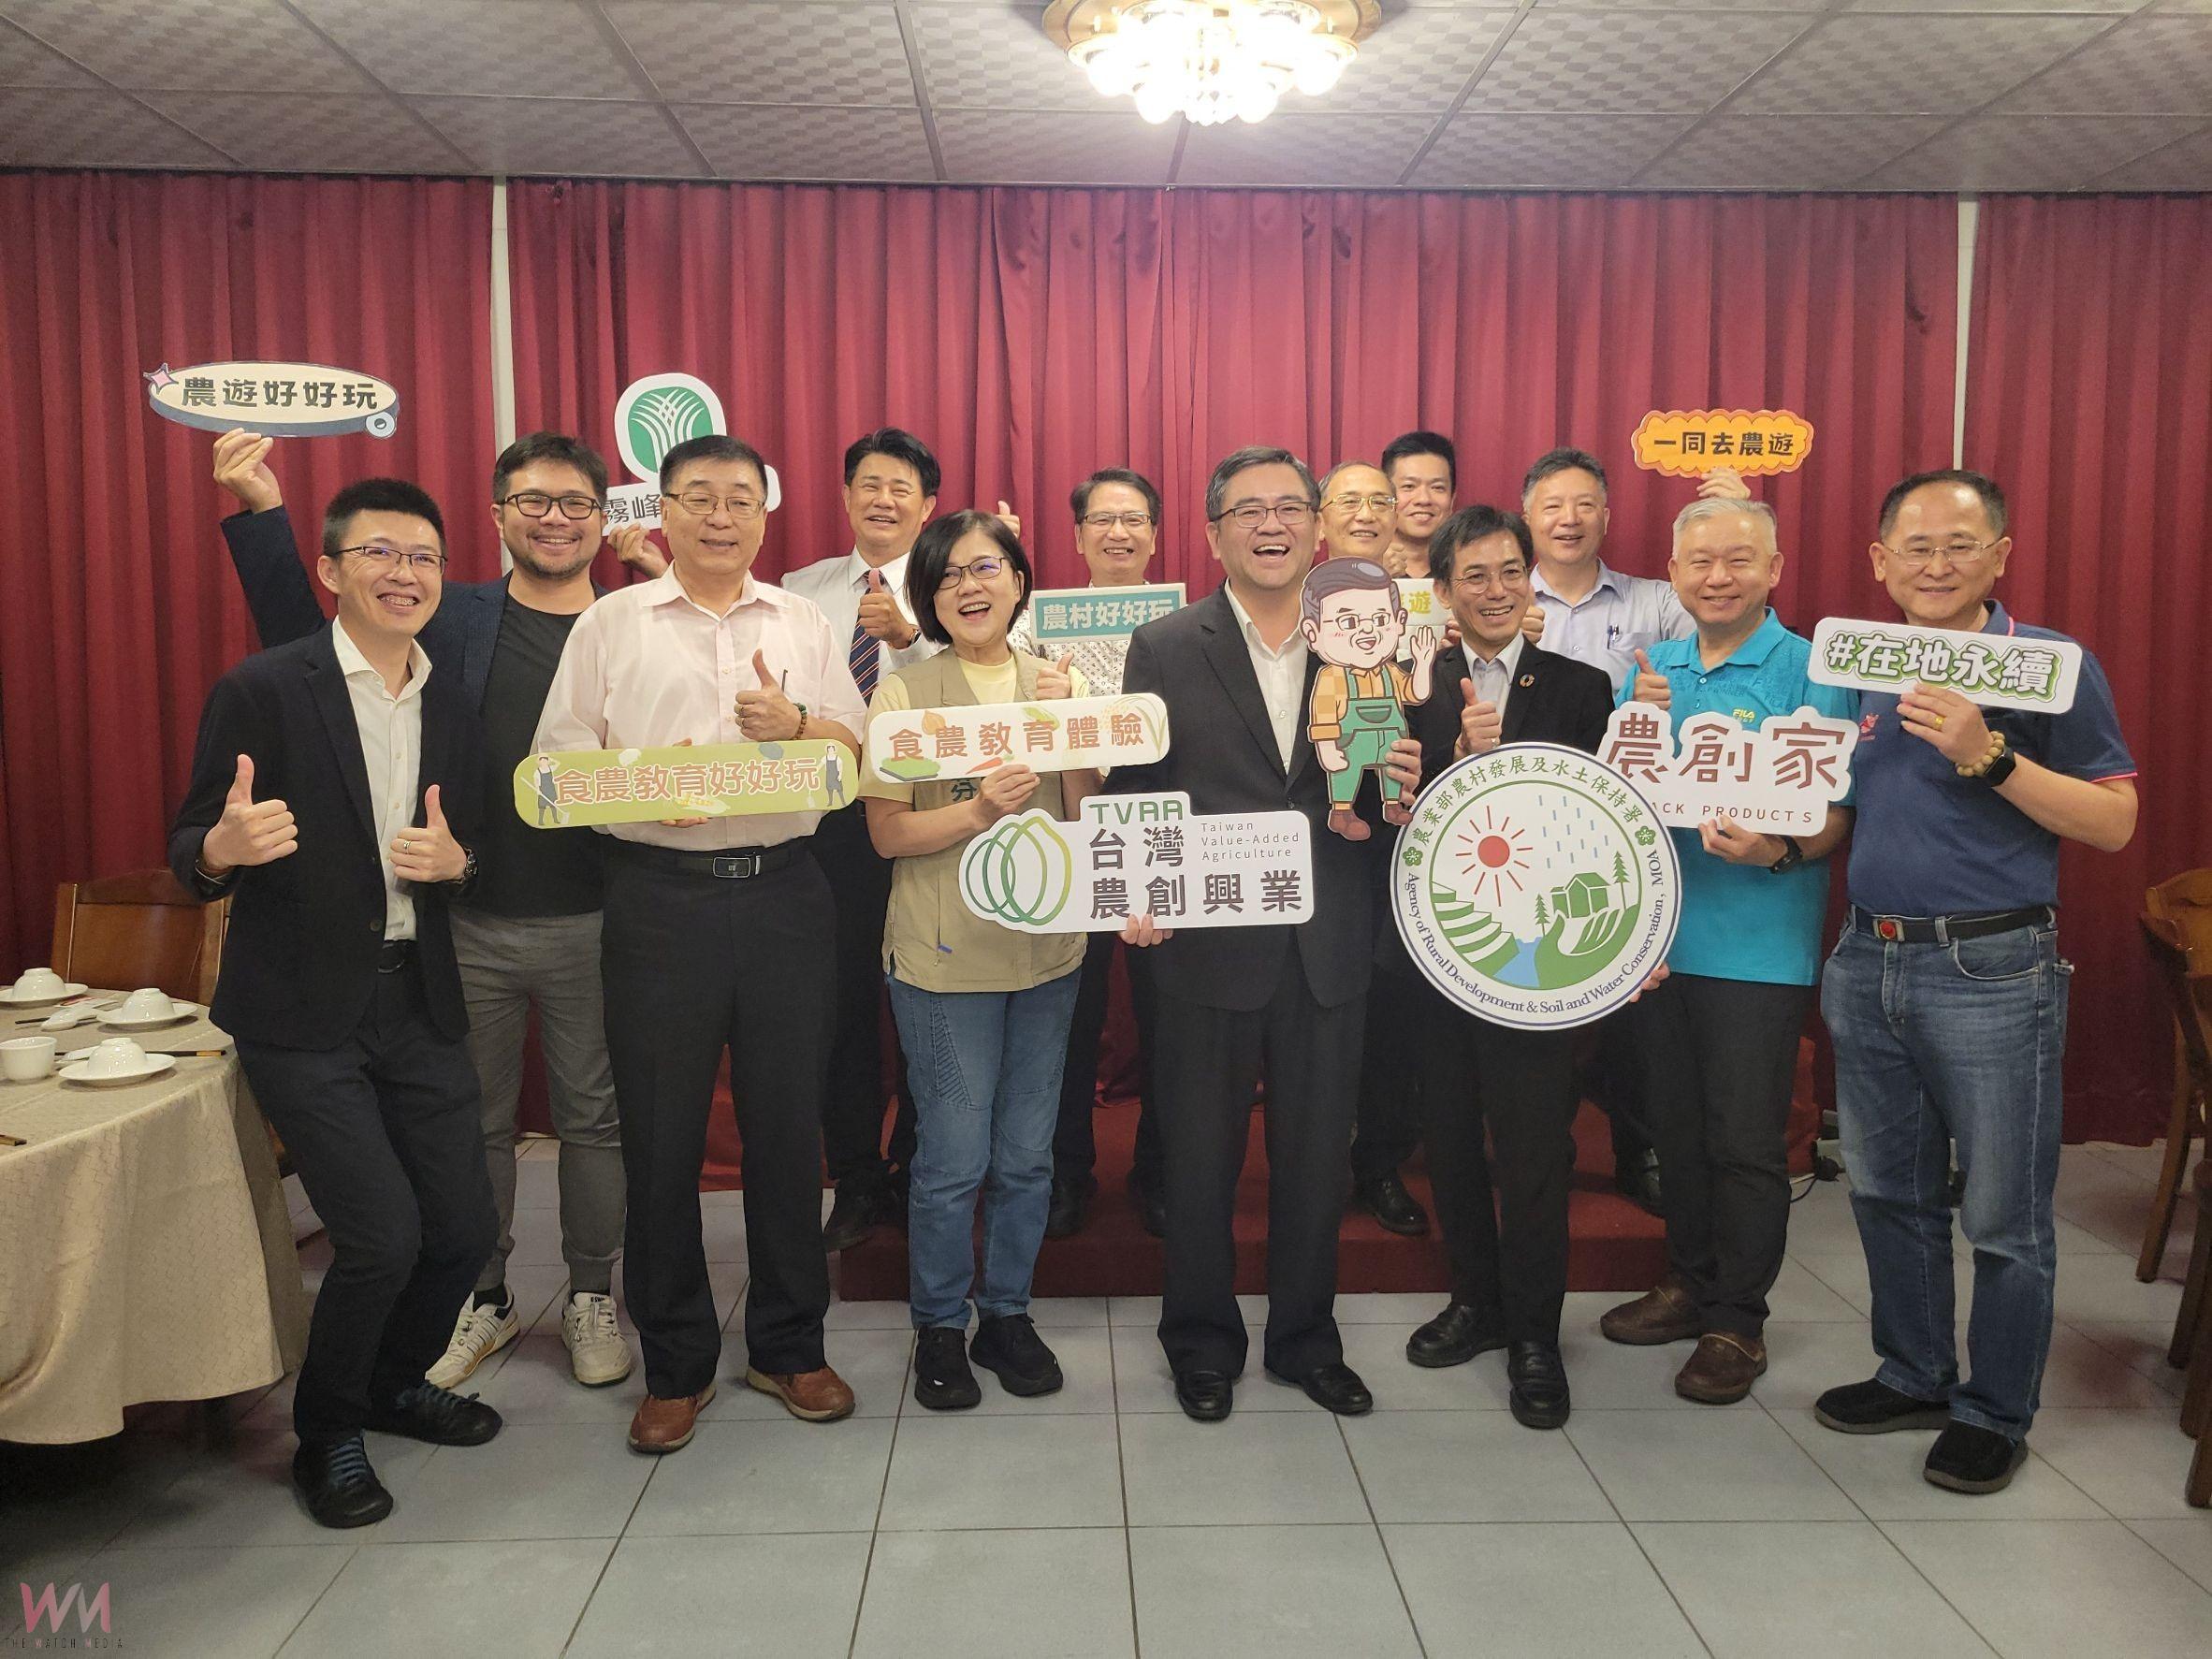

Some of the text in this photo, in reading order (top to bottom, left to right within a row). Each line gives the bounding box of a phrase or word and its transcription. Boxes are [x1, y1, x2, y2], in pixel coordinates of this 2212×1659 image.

[182, 377, 378, 410] 農遊好好玩
[1653, 431, 1794, 457] 一同去農遊
[1826, 633, 2054, 695] #在地永續
[1733, 708, 1755, 720] FILA
[889, 712, 1145, 762] 食農教育體驗
[1606, 712, 1846, 791] 農創家
[554, 759, 821, 806] 食農教育好好玩
[1411, 755, 1643, 846] 農業部農村發展及水土保持署
[1702, 806, 1812, 823] PRODUCTS
[1201, 822, 1254, 832] Taiwan
[1201, 833, 1299, 846] Value-Added
[1089, 825, 1184, 871] 台灣
[1202, 849, 1291, 862] Agriculture
[1647, 850, 1664, 886] MOA
[1090, 870, 1302, 920] 農創興業
[1405, 872, 1421, 920] Agency
[1416, 921, 1431, 934] of
[1421, 932, 1449, 968] Rural
[1446, 961, 1524, 1011] Development
[1566, 993, 1592, 1009] and
[1590, 973, 1624, 999] Water
[1526, 1000, 1538, 1012] &
[1540, 1000, 1564, 1012] Soil
